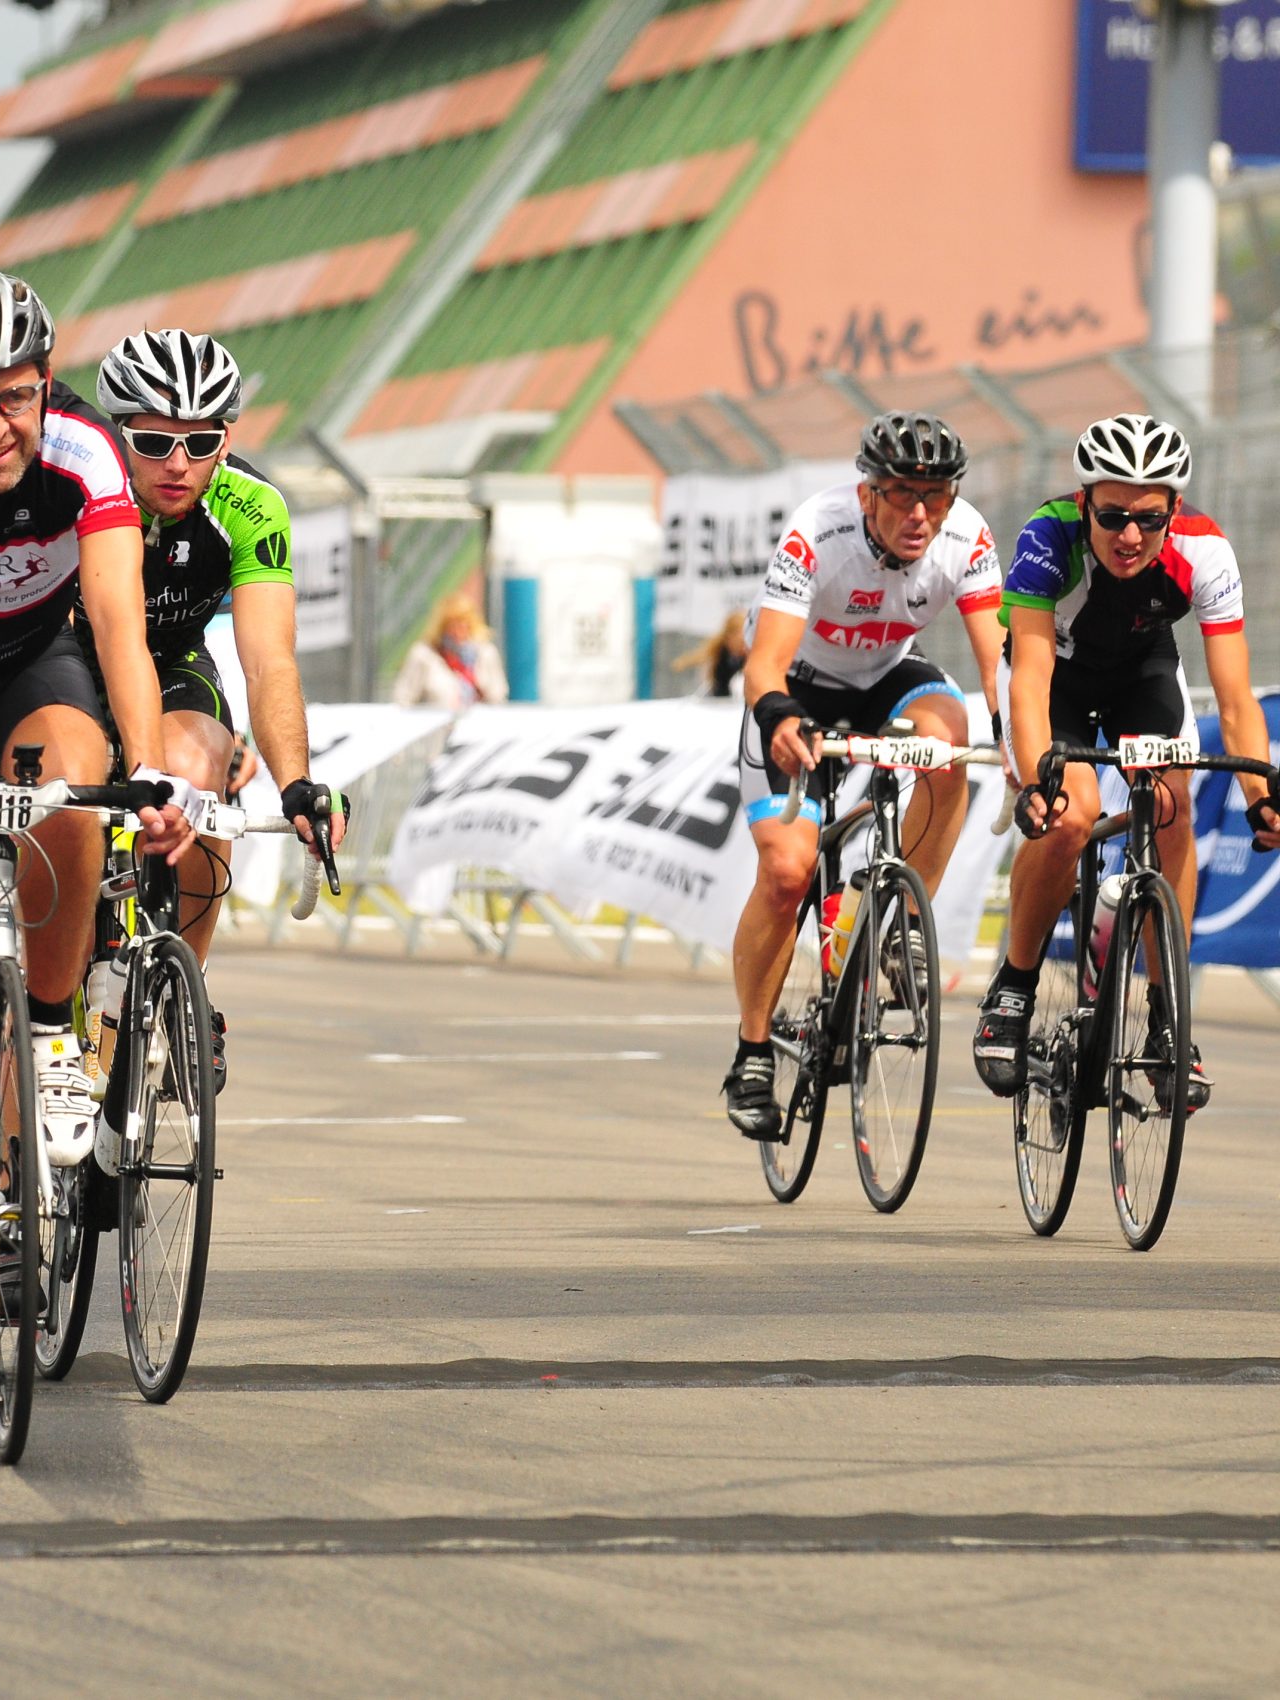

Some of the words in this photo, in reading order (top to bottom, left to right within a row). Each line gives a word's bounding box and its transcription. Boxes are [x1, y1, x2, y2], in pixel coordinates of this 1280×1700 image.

[734, 292, 936, 397] Bitte
[977, 292, 1104, 348] ein
[90, 1013, 100, 1080] NUTITION
